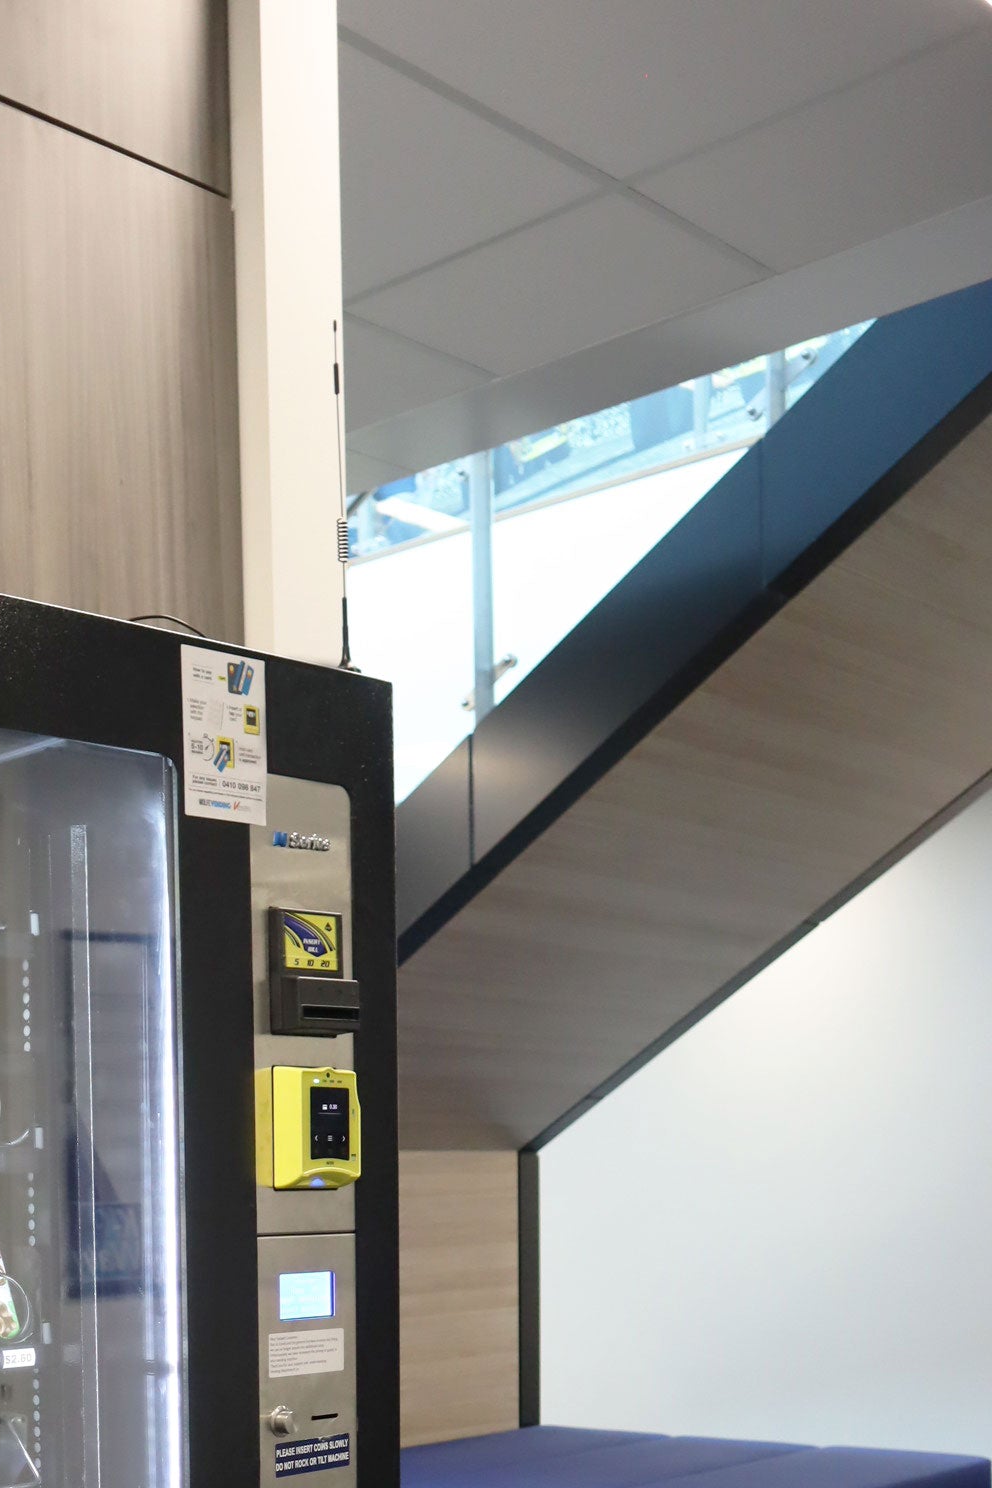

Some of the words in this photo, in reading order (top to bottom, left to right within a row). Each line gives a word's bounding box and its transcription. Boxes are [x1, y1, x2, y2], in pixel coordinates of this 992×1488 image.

[5, 1352, 32, 1365] $2.60
[276, 1447, 295, 1458] PLEASE
[296, 1444, 314, 1455] INSERT
[329, 1438, 349, 1449] SLOWLY
[275, 1462, 284, 1472] DO
[284, 1460, 294, 1470] NOT
[295, 1458, 309, 1469] ROCK
[310, 1457, 317, 1466] OR
[317, 1455, 327, 1465] TILT
[328, 1451, 350, 1463] MACHINE
